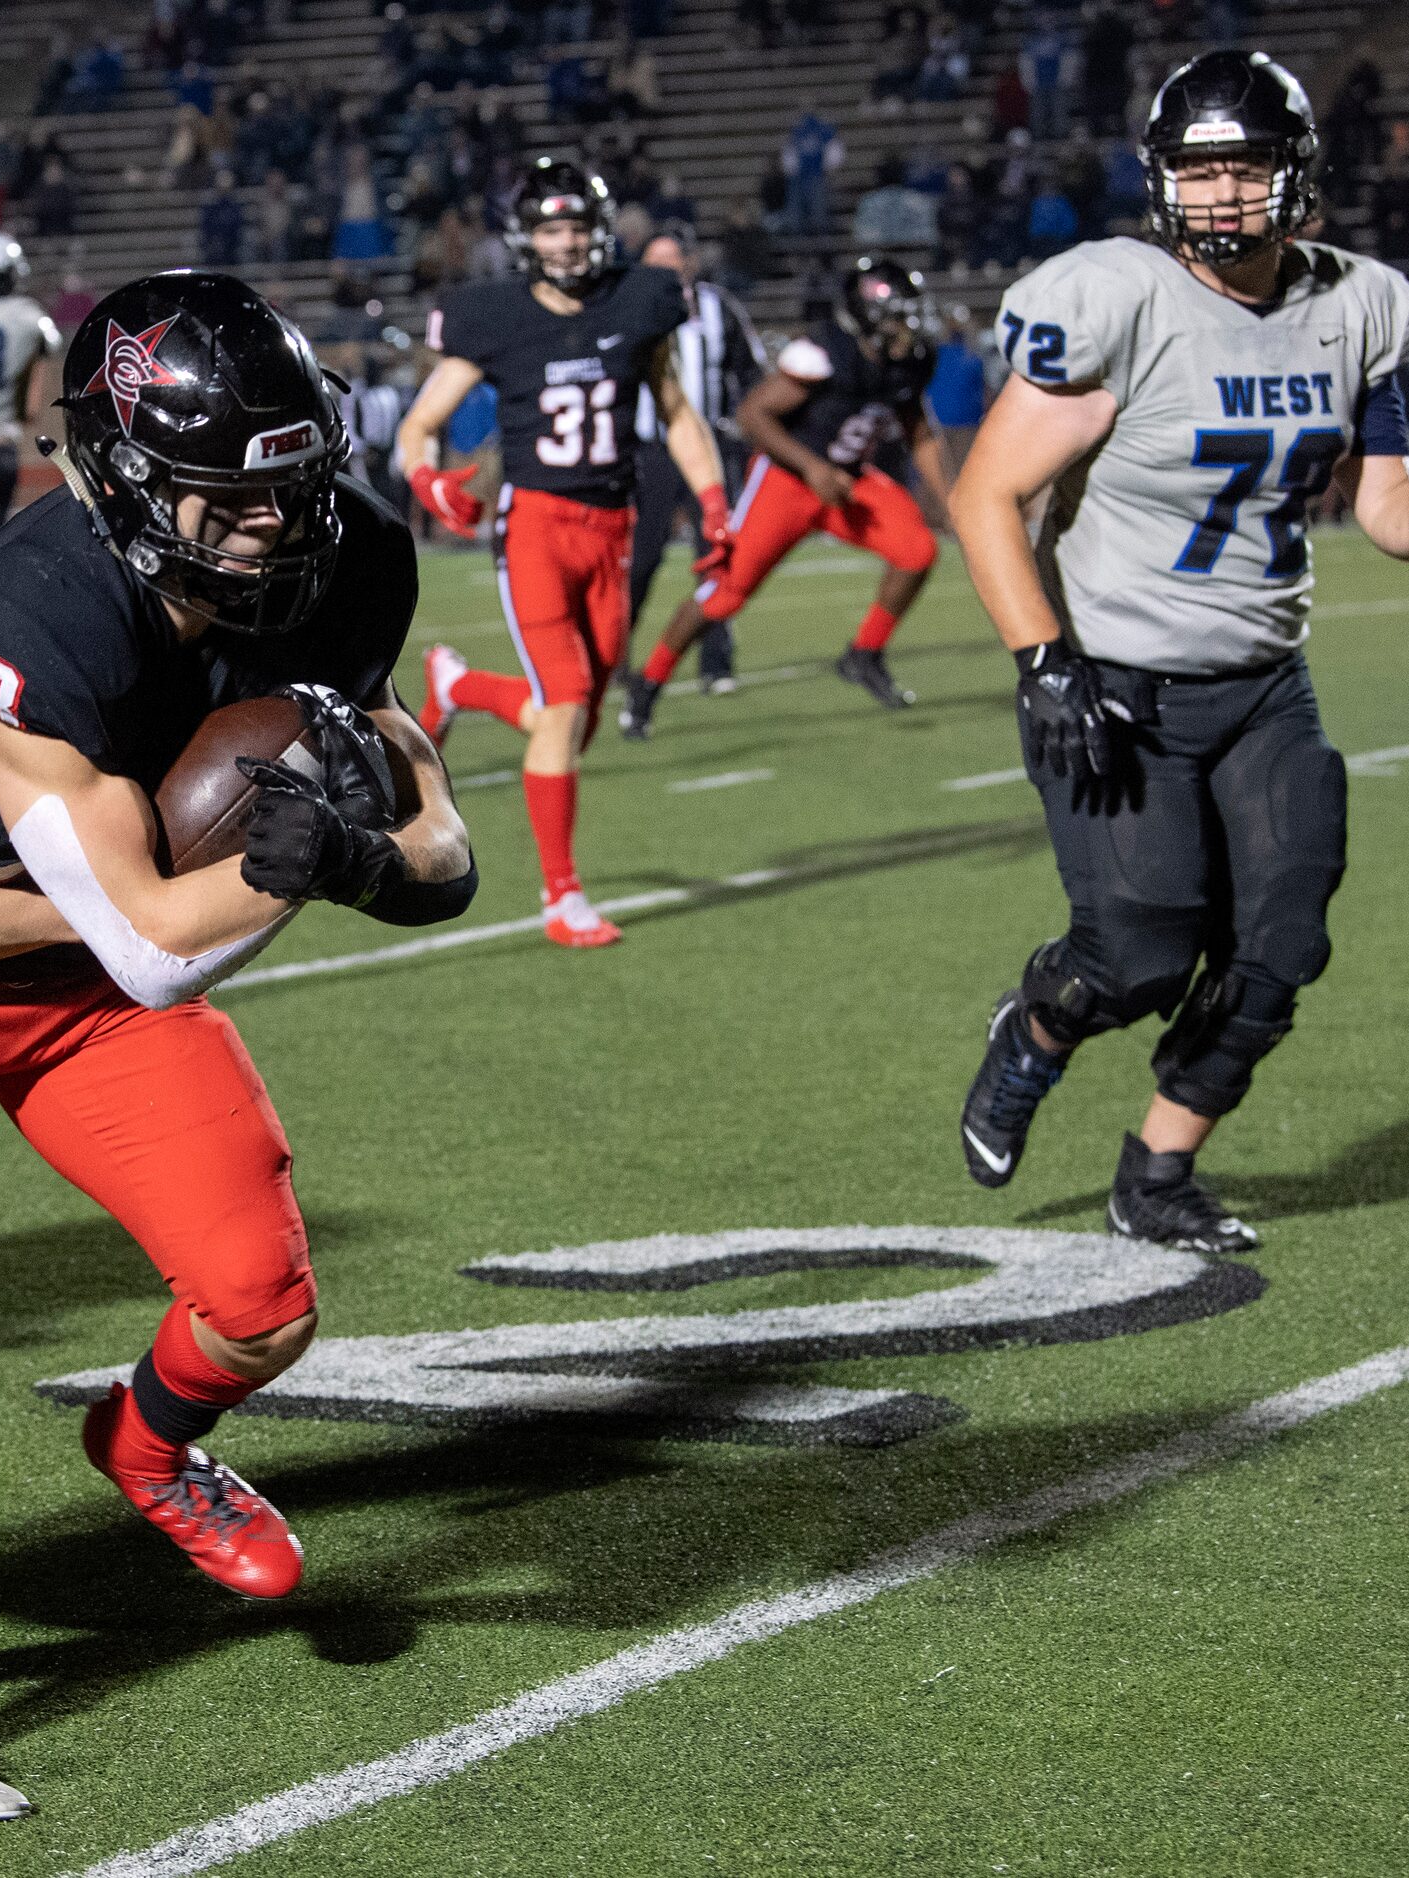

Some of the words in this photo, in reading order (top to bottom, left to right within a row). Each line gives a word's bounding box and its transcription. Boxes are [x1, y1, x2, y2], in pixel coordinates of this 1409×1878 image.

[1002, 310, 1067, 384] 72
[536, 378, 618, 468] 31
[1213, 372, 1334, 419] WEST
